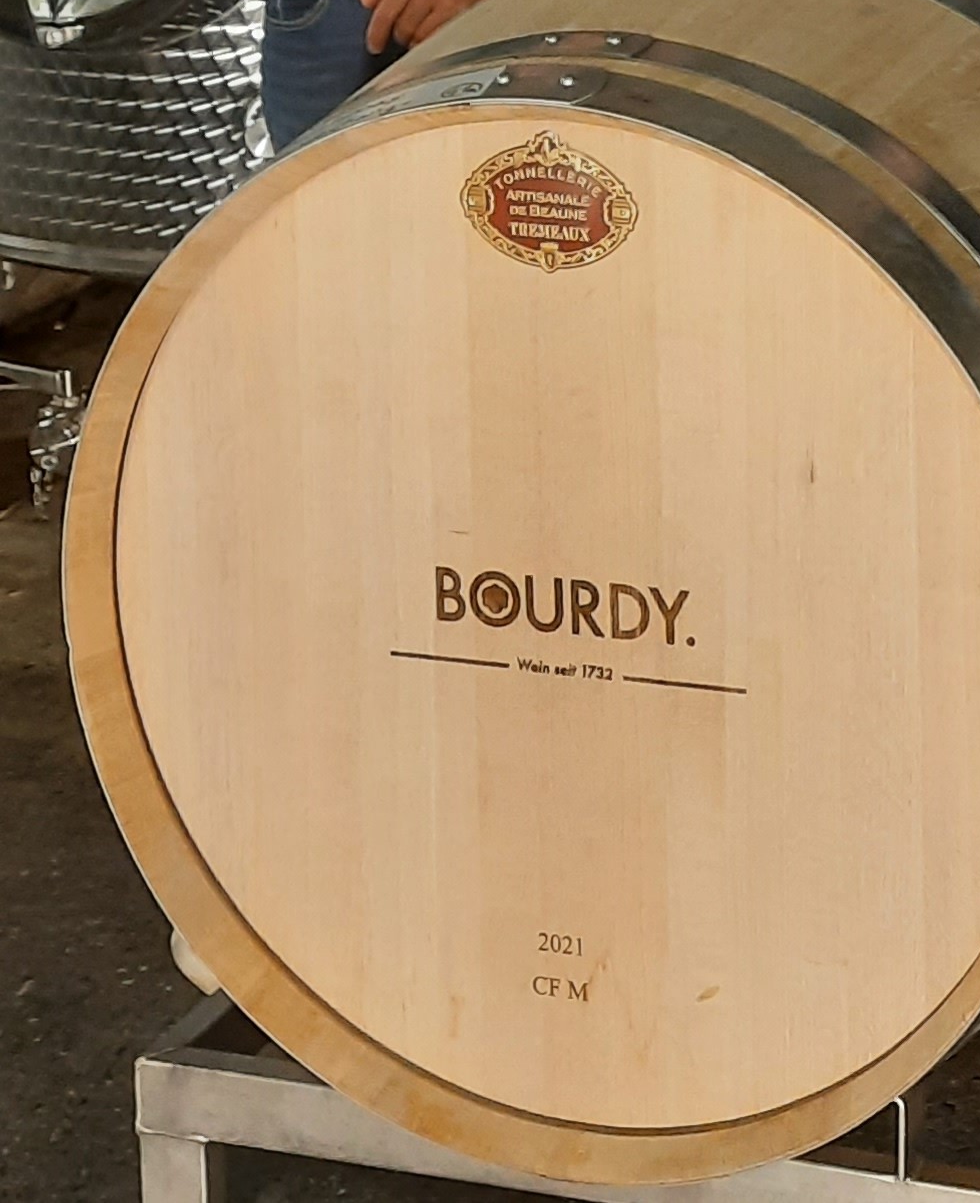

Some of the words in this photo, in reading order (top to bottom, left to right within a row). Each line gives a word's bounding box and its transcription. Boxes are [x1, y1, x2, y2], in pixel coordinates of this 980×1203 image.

[494, 165, 602, 198] TONNELLERIE
[506, 189, 591, 207] ARTISANALE
[509, 205, 527, 217] DE
[529, 204, 588, 221] BEAUNE
[435, 565, 696, 648] BOURDY.
[516, 656, 550, 674] Wein
[554, 663, 577, 677] seit
[582, 664, 613, 681] 1732
[538, 932, 583, 957] 2021
[532, 975, 561, 997] CF
[568, 979, 589, 1002] M
